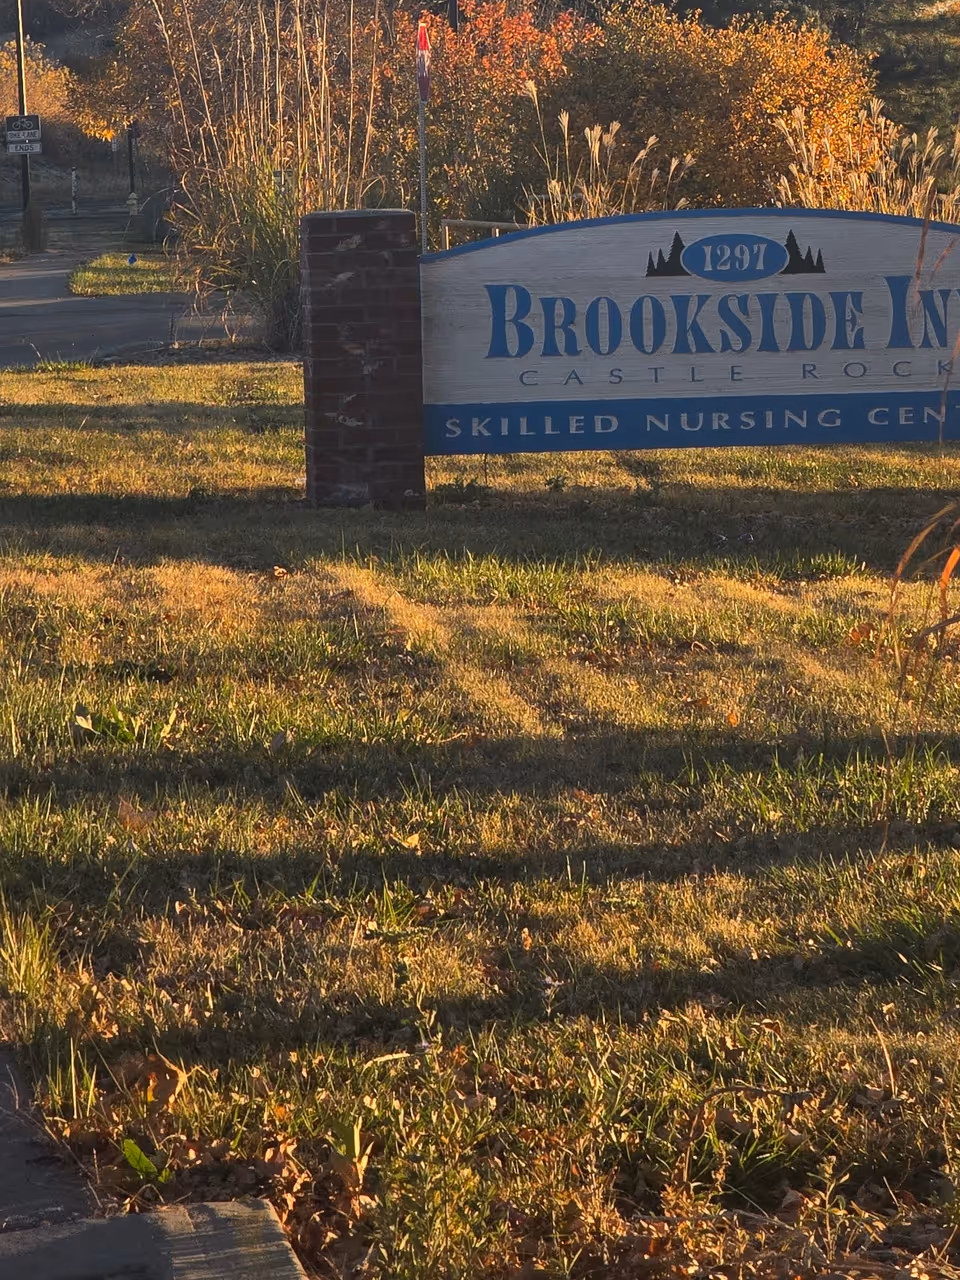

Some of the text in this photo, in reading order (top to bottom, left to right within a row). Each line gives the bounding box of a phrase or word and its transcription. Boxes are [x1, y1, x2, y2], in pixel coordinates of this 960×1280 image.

[703, 244, 767, 272] 1297
[483, 283, 865, 359] BROOKSIDE
[519, 359, 953, 387] CASTLE ROCK
[445, 415, 620, 439] SKILLED
[646, 409, 843, 432] NURSING
